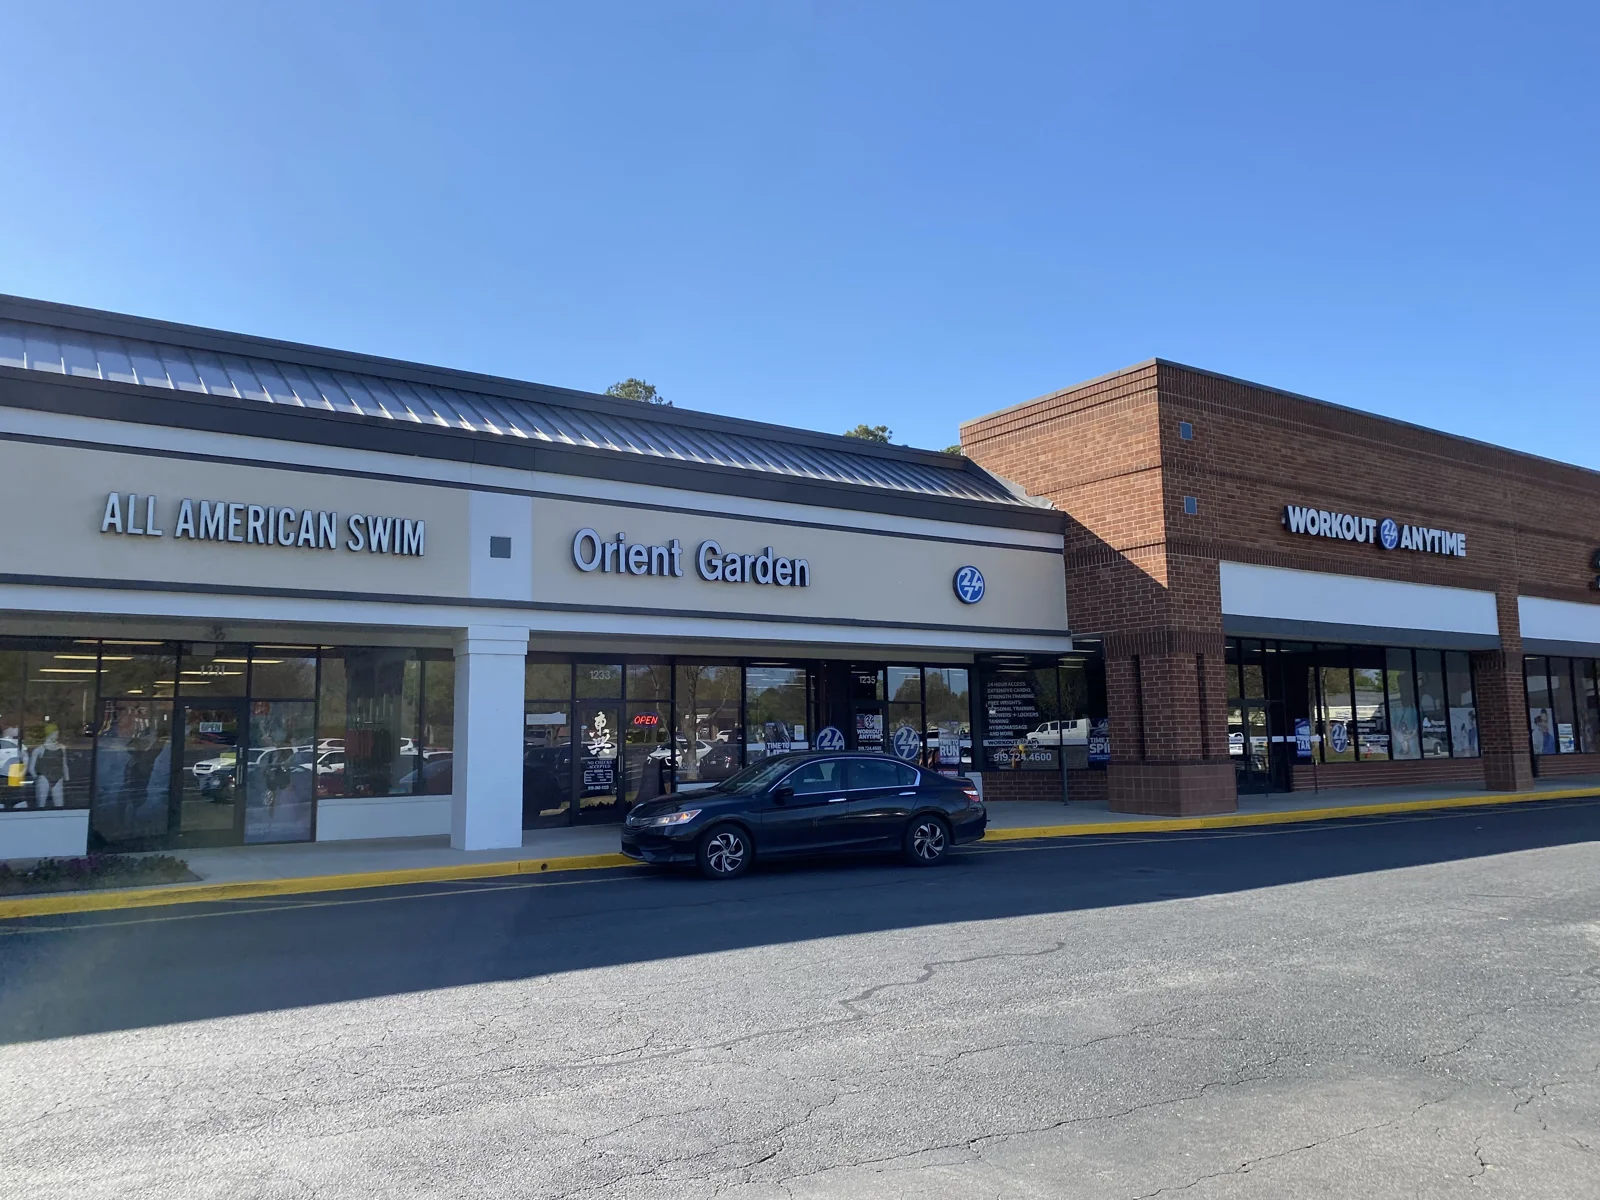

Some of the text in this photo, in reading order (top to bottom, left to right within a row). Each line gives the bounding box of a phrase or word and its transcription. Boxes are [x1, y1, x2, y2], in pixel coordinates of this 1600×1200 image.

[101, 491, 426, 557] ALL AMERICAN SWIM
[1286, 504, 1467, 557] WORKOUT ANYTIME
[572, 527, 811, 587] Orient Garden
[958, 569, 983, 591] 24
[963, 587, 975, 601] 7
[589, 670, 611, 680] 1233
[859, 675, 876, 684] 1235
[634, 715, 659, 725] OPEN
[201, 723, 222, 732] OPEN
[820, 729, 844, 751] 24
[896, 728, 919, 750] 24
[1296, 740, 1311, 750] TAN
[899, 746, 911, 760] 7
[940, 745, 959, 757] RUN
